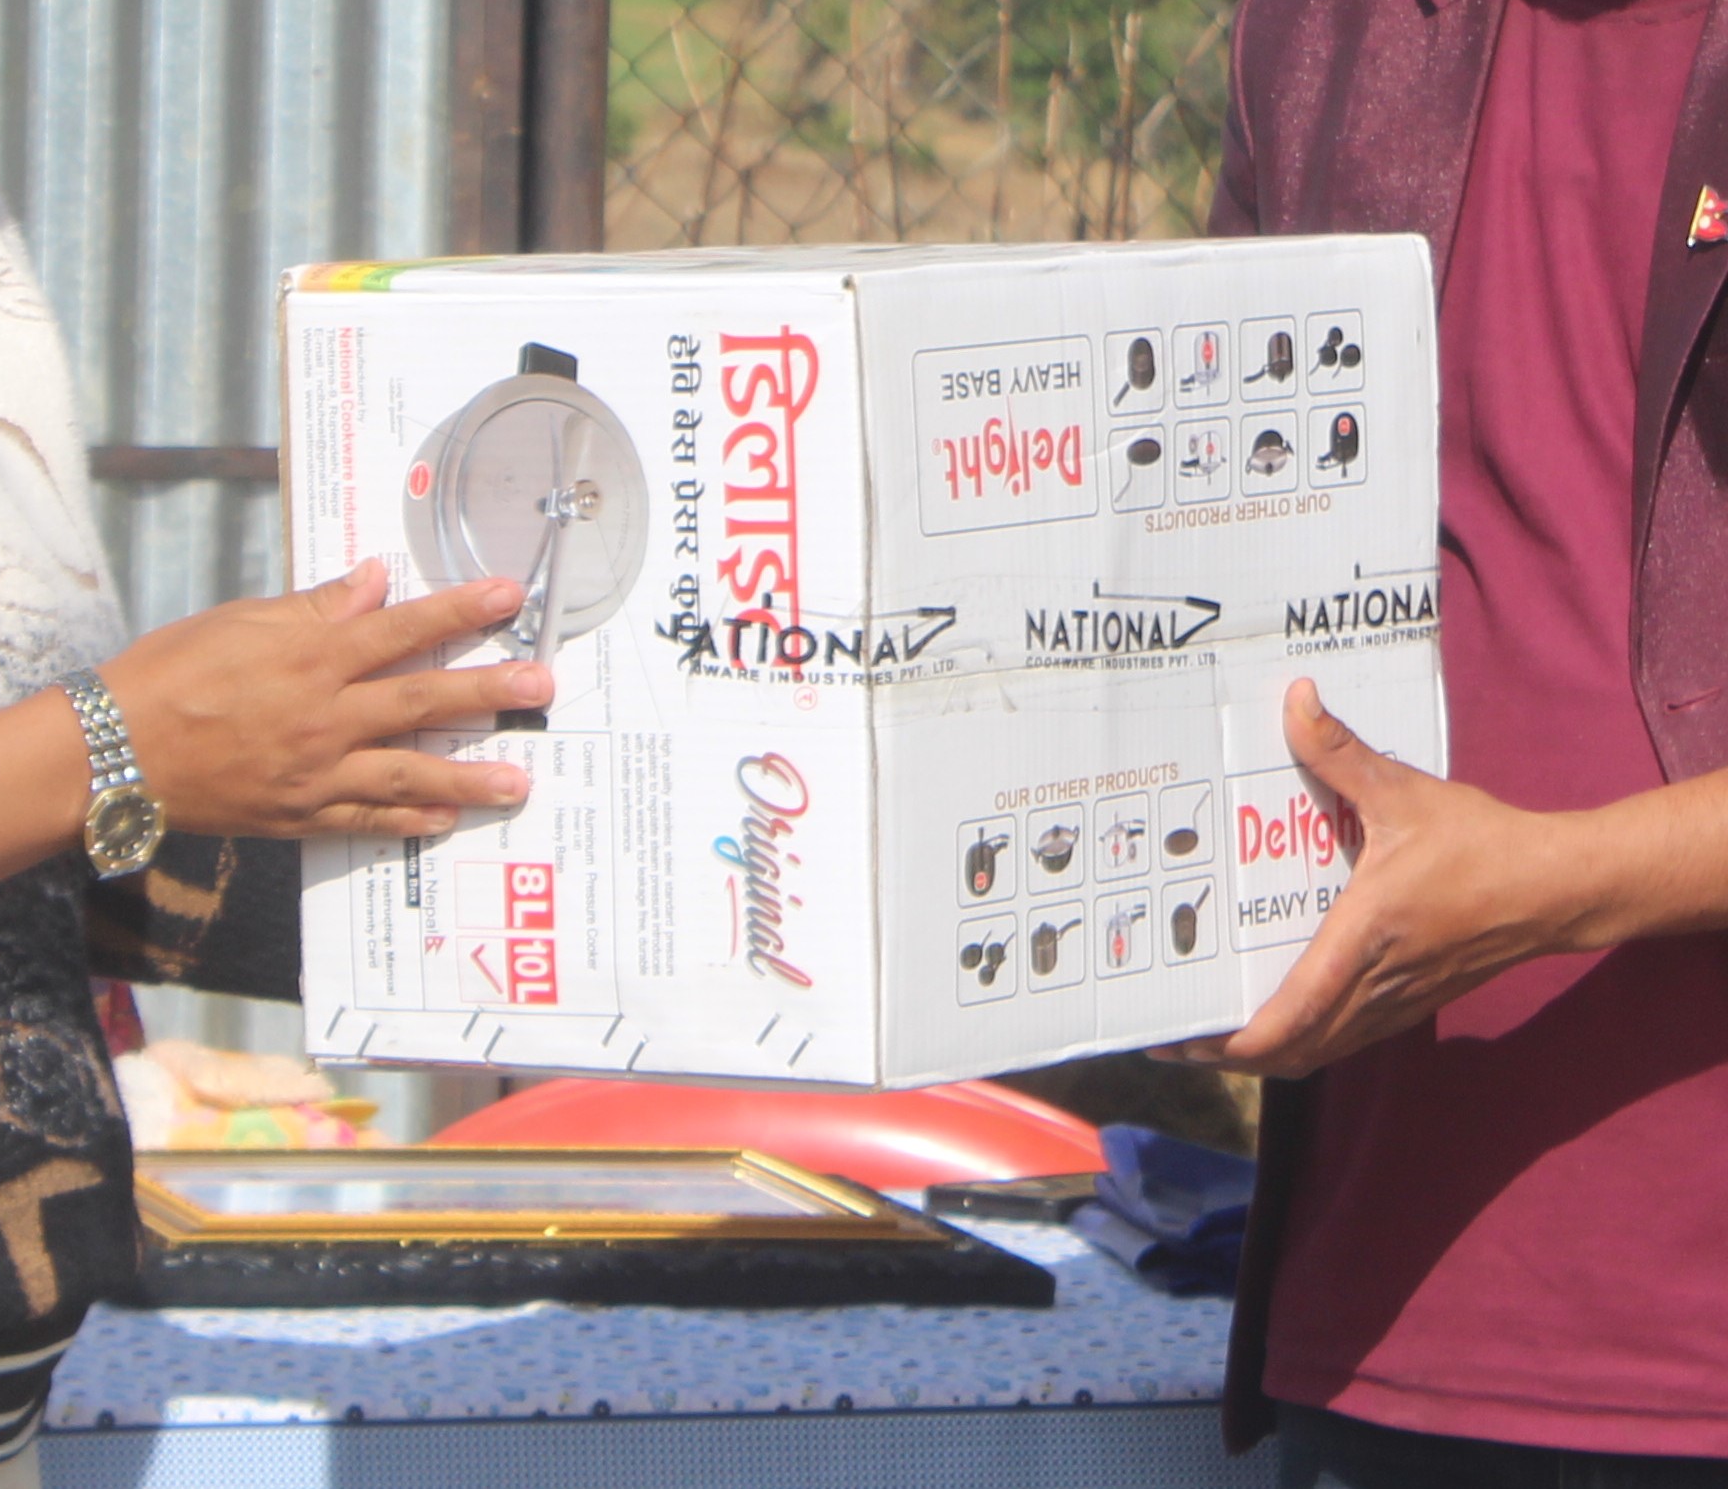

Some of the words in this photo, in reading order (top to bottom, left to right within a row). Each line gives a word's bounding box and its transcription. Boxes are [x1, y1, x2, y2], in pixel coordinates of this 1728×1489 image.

[339, 327, 354, 394] National
[356, 327, 366, 405] Manufactured
[1009, 360, 1081, 396] HEAVY
[941, 368, 1000, 400] BASE
[341, 399, 355, 481] Cookware
[672, 409, 703, 466] बेस
[943, 403, 1083, 501] Delight
[330, 481, 340, 518] Nepal
[671, 479, 705, 562] प्रेसर
[1145, 504, 1230, 533] PRODUCTS
[1236, 499, 1290, 521] OTHER
[1296, 495, 1331, 516] OUR
[343, 486, 356, 567] Industries
[1026, 600, 1220, 651] NATIONAL
[1287, 636, 1355, 656] COOKWARE
[770, 669, 893, 686] INDUSTRIES
[1026, 656, 1095, 670] COOKWARE
[1100, 655, 1164, 670] INDUSTRIES
[554, 740, 566, 776] Model
[583, 740, 595, 787] Content
[660, 734, 672, 757] High
[661, 762, 672, 796] quality
[995, 788, 1030, 811] OUR
[1035, 781, 1090, 805] OTHER
[1094, 762, 1179, 795] PRODUCTS
[499, 817, 511, 850] Piece
[553, 807, 566, 842] Heavy
[585, 807, 597, 865] Aluminum
[663, 801, 673, 846] stainless
[424, 857, 438, 872] in
[555, 845, 567, 873] Base
[664, 851, 674, 876] steel
[713, 752, 815, 988] Original
[365, 880, 376, 934] Warranty
[409, 878, 419, 902] Box
[423, 880, 439, 934] Nepal
[586, 873, 598, 924] Pressure
[665, 882, 674, 926] standard
[1238, 890, 1308, 927] HEAVY
[382, 880, 393, 947] Instruction
[367, 939, 378, 968] Card
[587, 928, 599, 970] Cooker
[663, 931, 674, 976] pressure
[385, 951, 396, 996] Manual
